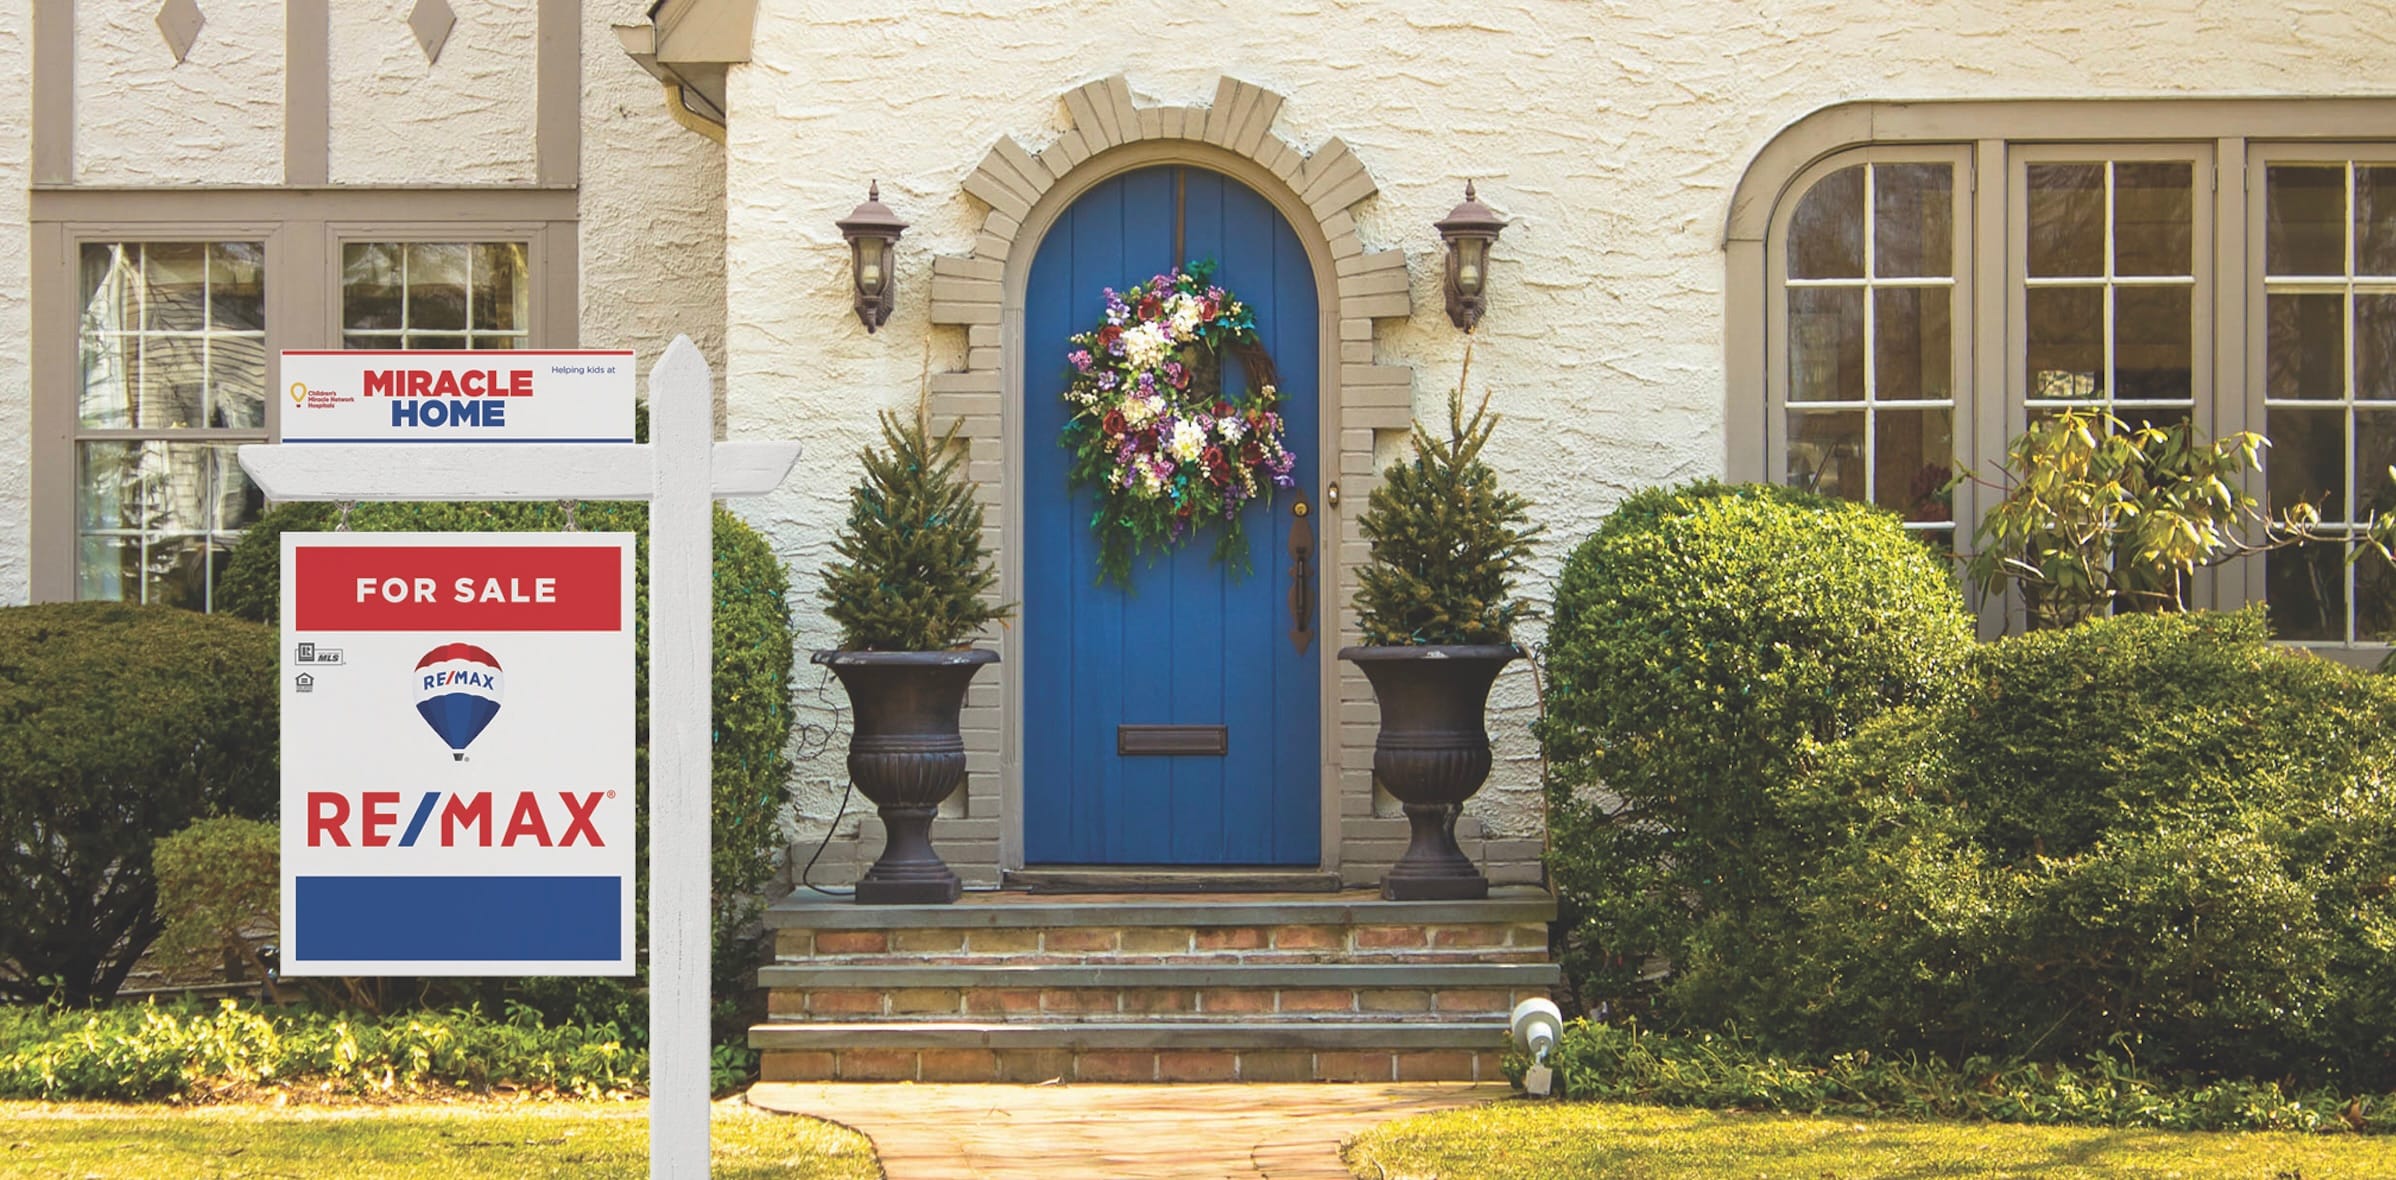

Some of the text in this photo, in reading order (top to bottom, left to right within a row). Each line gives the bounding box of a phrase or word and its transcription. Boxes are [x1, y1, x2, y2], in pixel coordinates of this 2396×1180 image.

[551, 366, 585, 375] Helping
[587, 366, 605, 374] kids
[363, 370, 533, 397] MIRACLE
[392, 400, 505, 427] HOME
[357, 578, 556, 603] FOR SALE
[424, 670, 494, 690] RE/MAX
